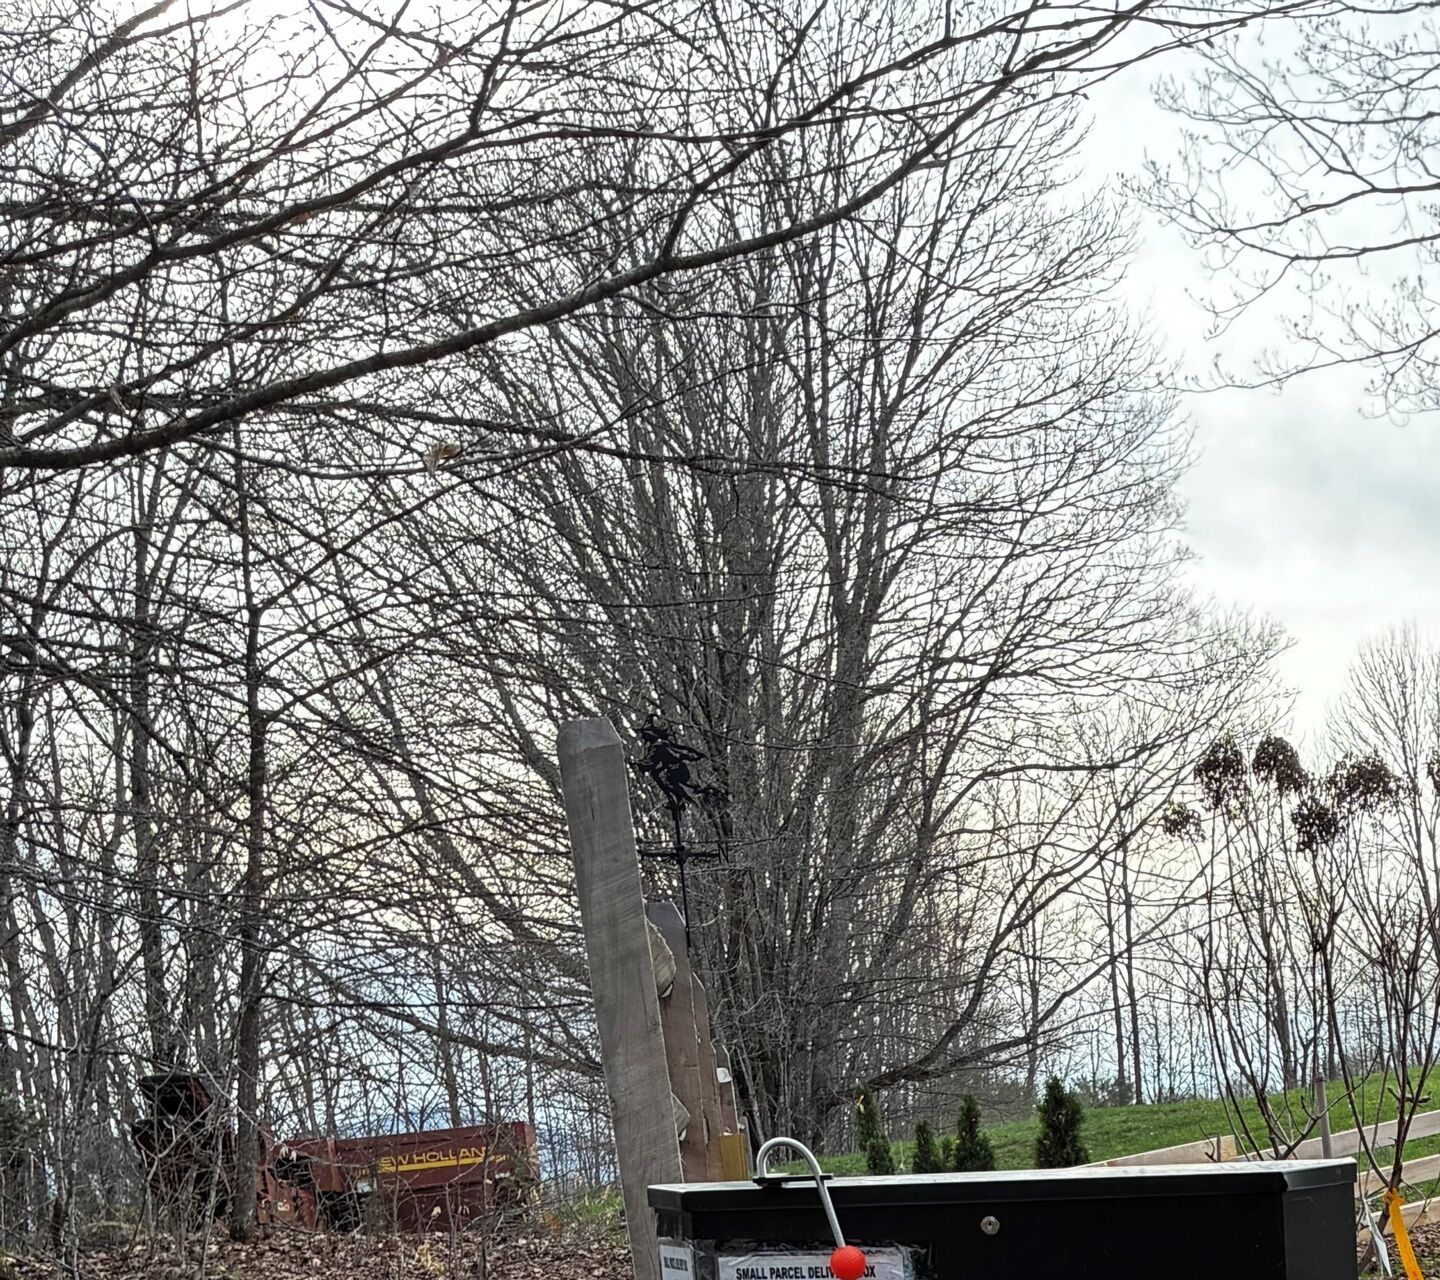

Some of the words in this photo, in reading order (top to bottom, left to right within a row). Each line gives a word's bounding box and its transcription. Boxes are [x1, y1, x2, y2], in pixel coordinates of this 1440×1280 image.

[413, 1146, 486, 1164] HOLLAN
[735, 1266, 768, 1280] SMALL
[769, 1265, 806, 1280] PARCEL
